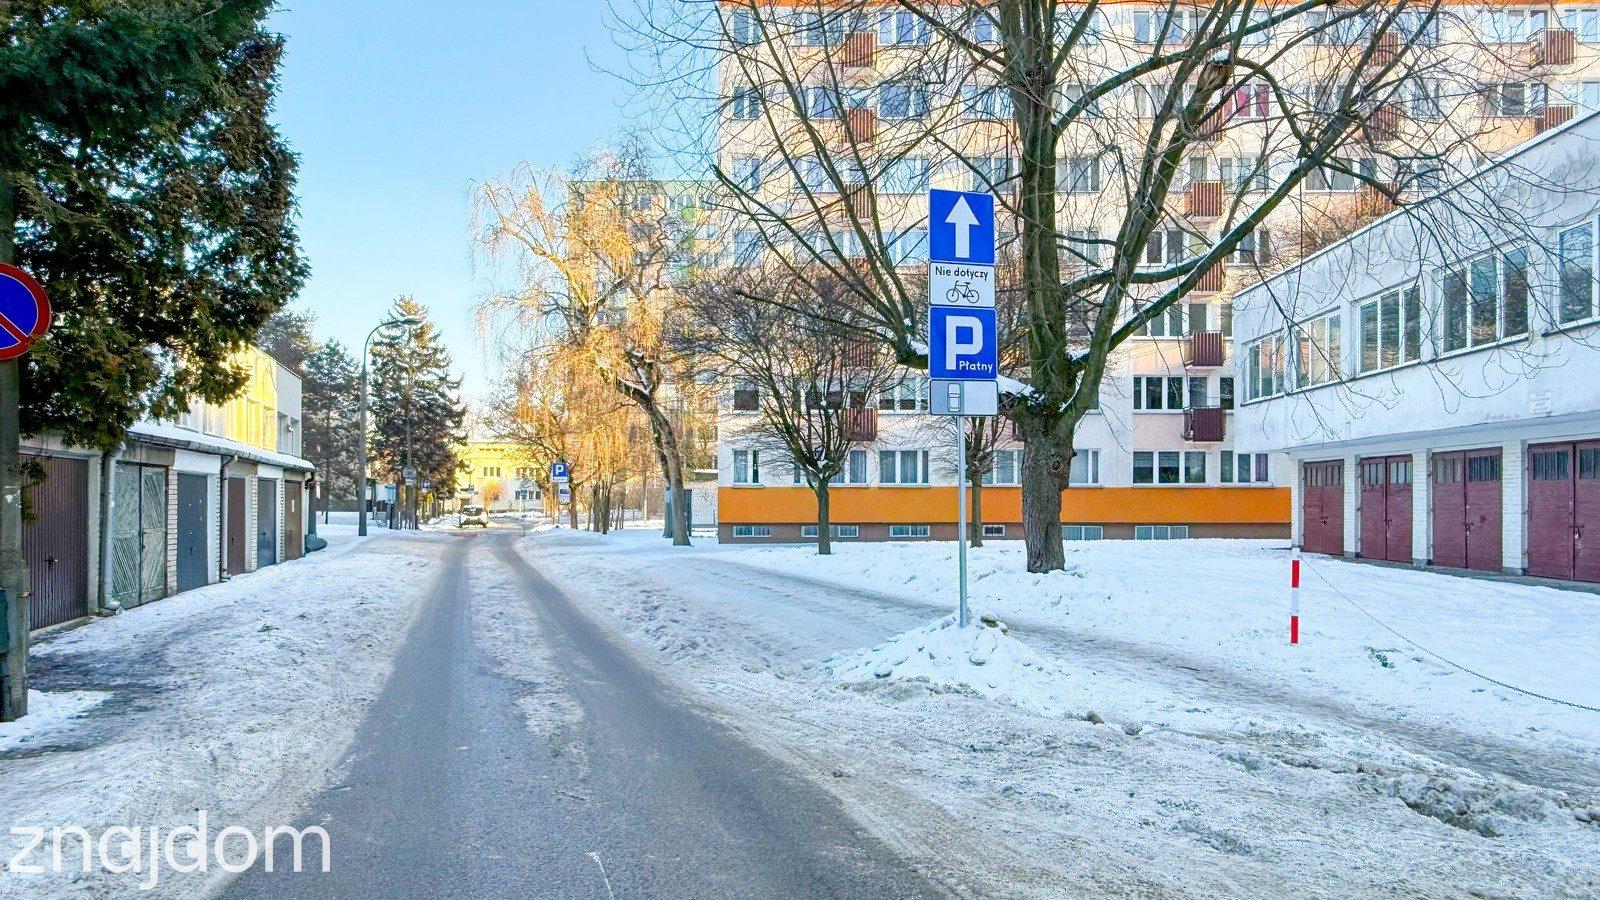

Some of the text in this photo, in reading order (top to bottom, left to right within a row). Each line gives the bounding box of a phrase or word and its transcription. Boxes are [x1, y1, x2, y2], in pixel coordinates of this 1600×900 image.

[935, 266, 988, 281] Nie dotyczy
[946, 315, 983, 370] P
[959, 360, 993, 373] Płatny
[555, 464, 564, 475] P
